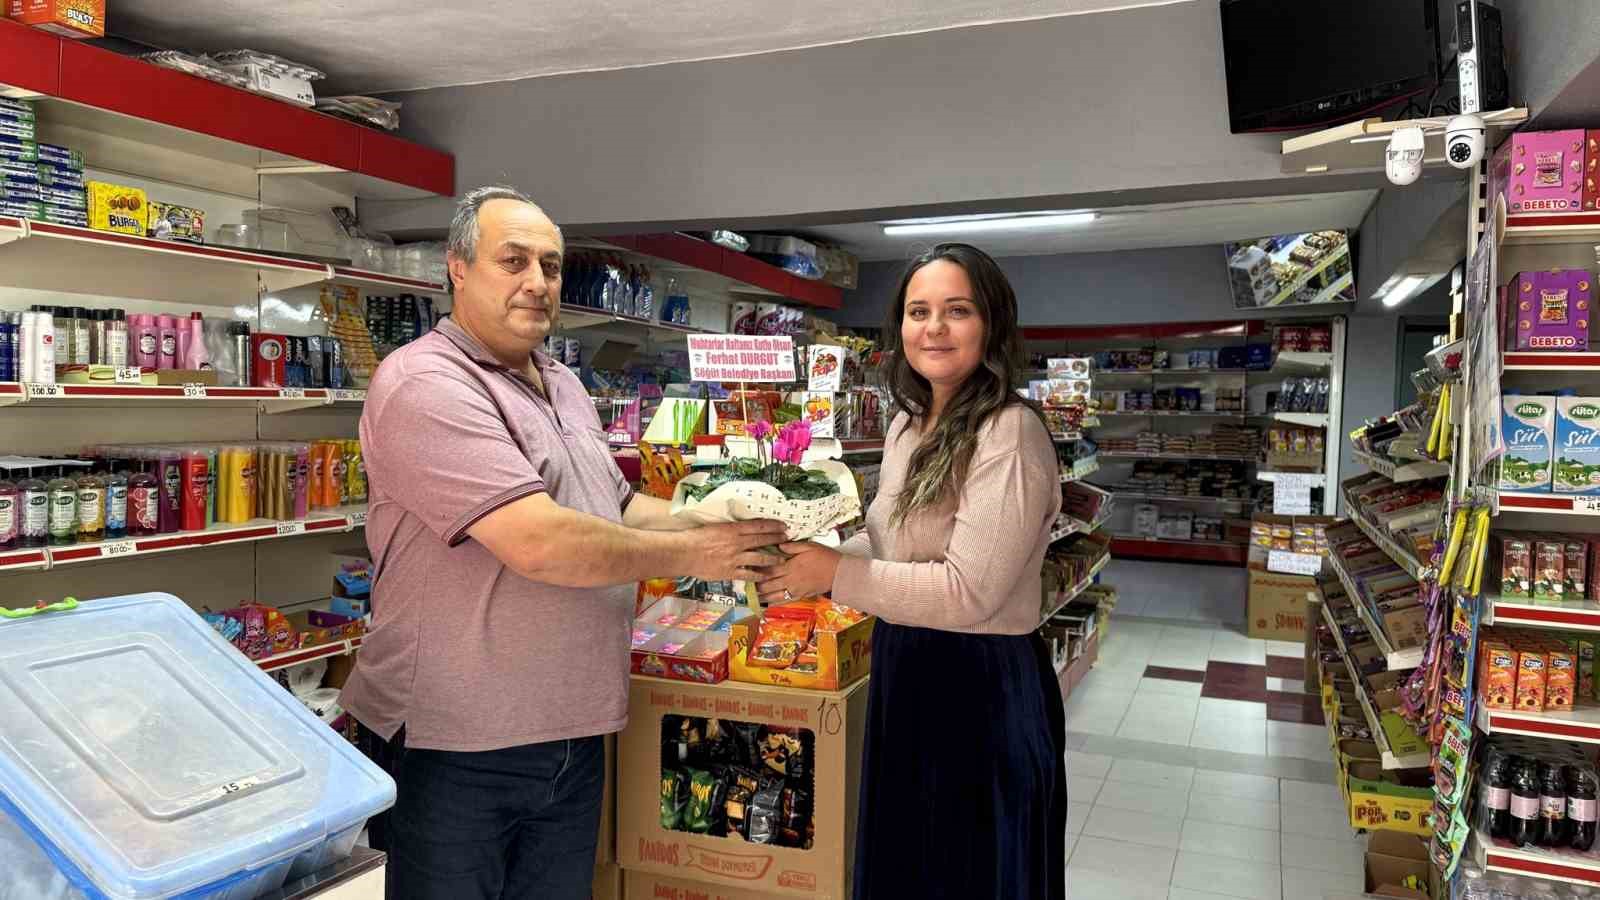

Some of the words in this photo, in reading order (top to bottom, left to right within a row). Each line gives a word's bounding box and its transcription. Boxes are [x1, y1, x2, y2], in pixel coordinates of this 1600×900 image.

[1524, 200, 1568, 210] BEBETO
[1531, 337, 1574, 346] BEBETO
[706, 352, 739, 364] Ferhat
[740, 353, 779, 365] DURGUT
[694, 367, 720, 379] Söğüt
[721, 368, 759, 379] Belediye
[760, 368, 795, 379] Başkanı
[1510, 428, 1545, 445] Süt
[1563, 429, 1600, 447] Süt
[817, 697, 842, 736] 10
[222, 782, 239, 794] 15
